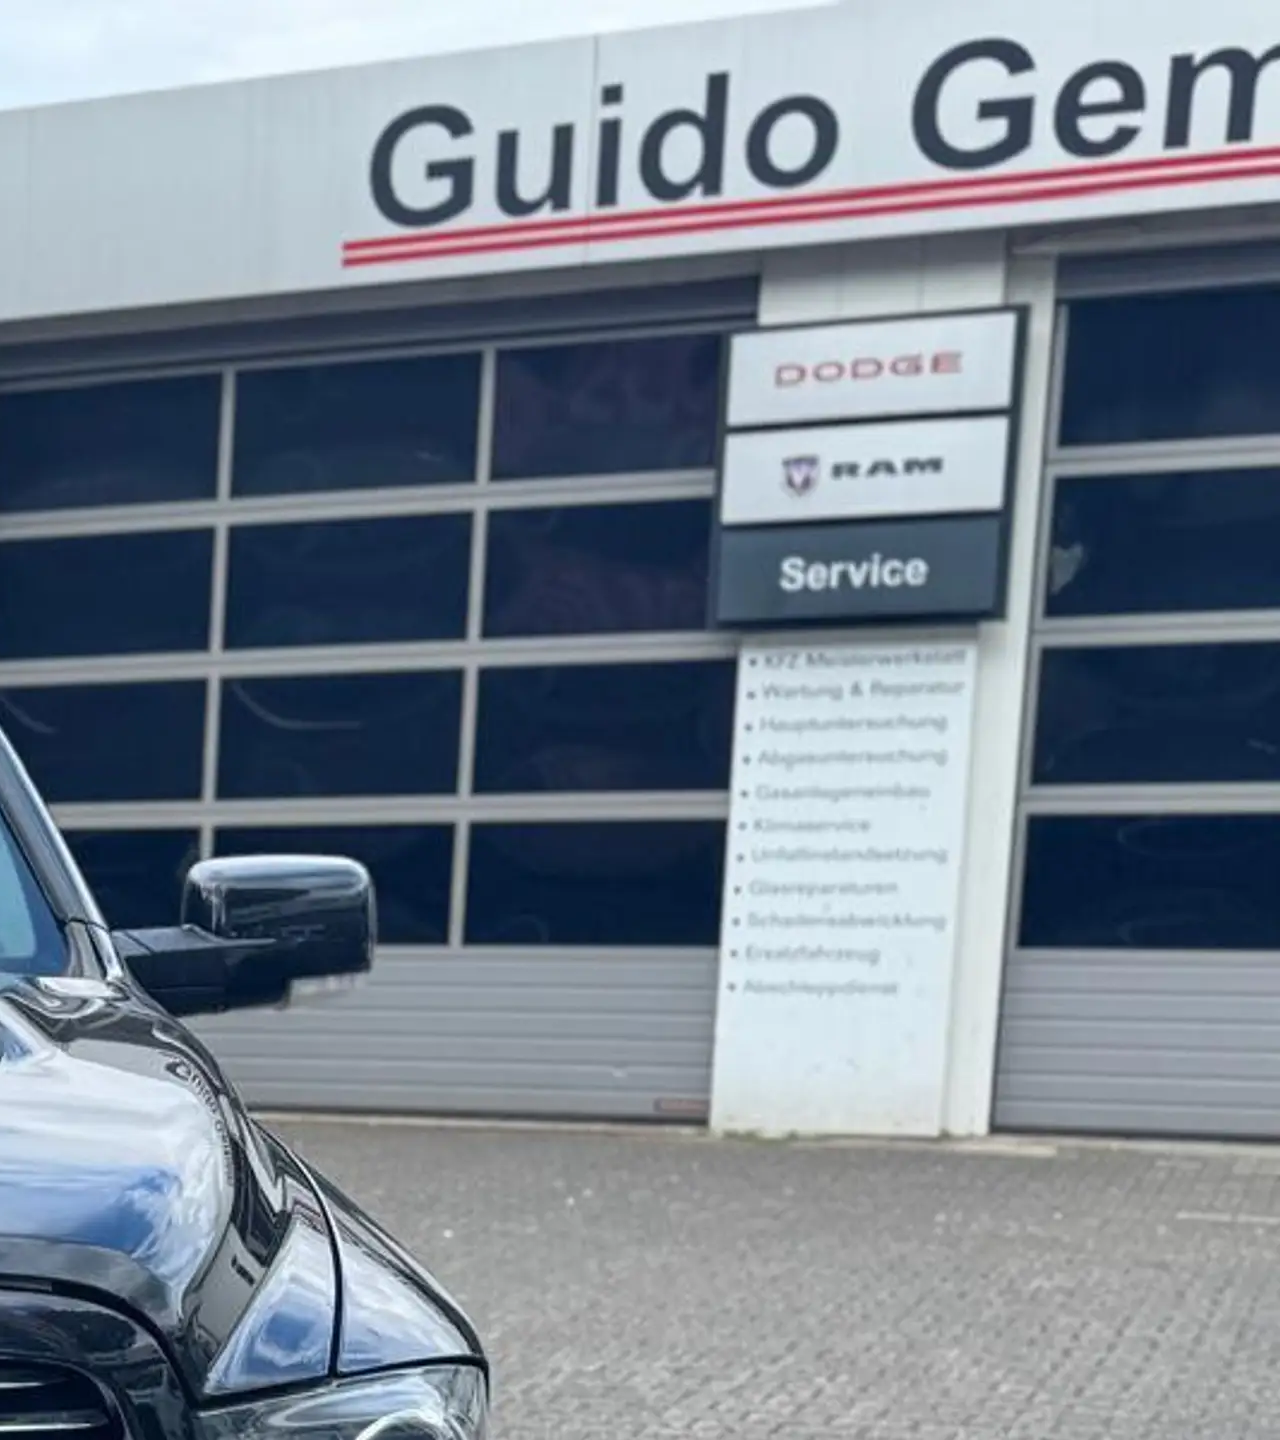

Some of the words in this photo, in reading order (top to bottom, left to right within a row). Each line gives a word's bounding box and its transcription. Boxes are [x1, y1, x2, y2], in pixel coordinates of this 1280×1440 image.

[368, 71, 840, 228] Guido
[910, 37, 1280, 171] Gem
[774, 351, 964, 388] DODGE
[830, 457, 944, 479] RAM
[779, 553, 930, 591] Service
